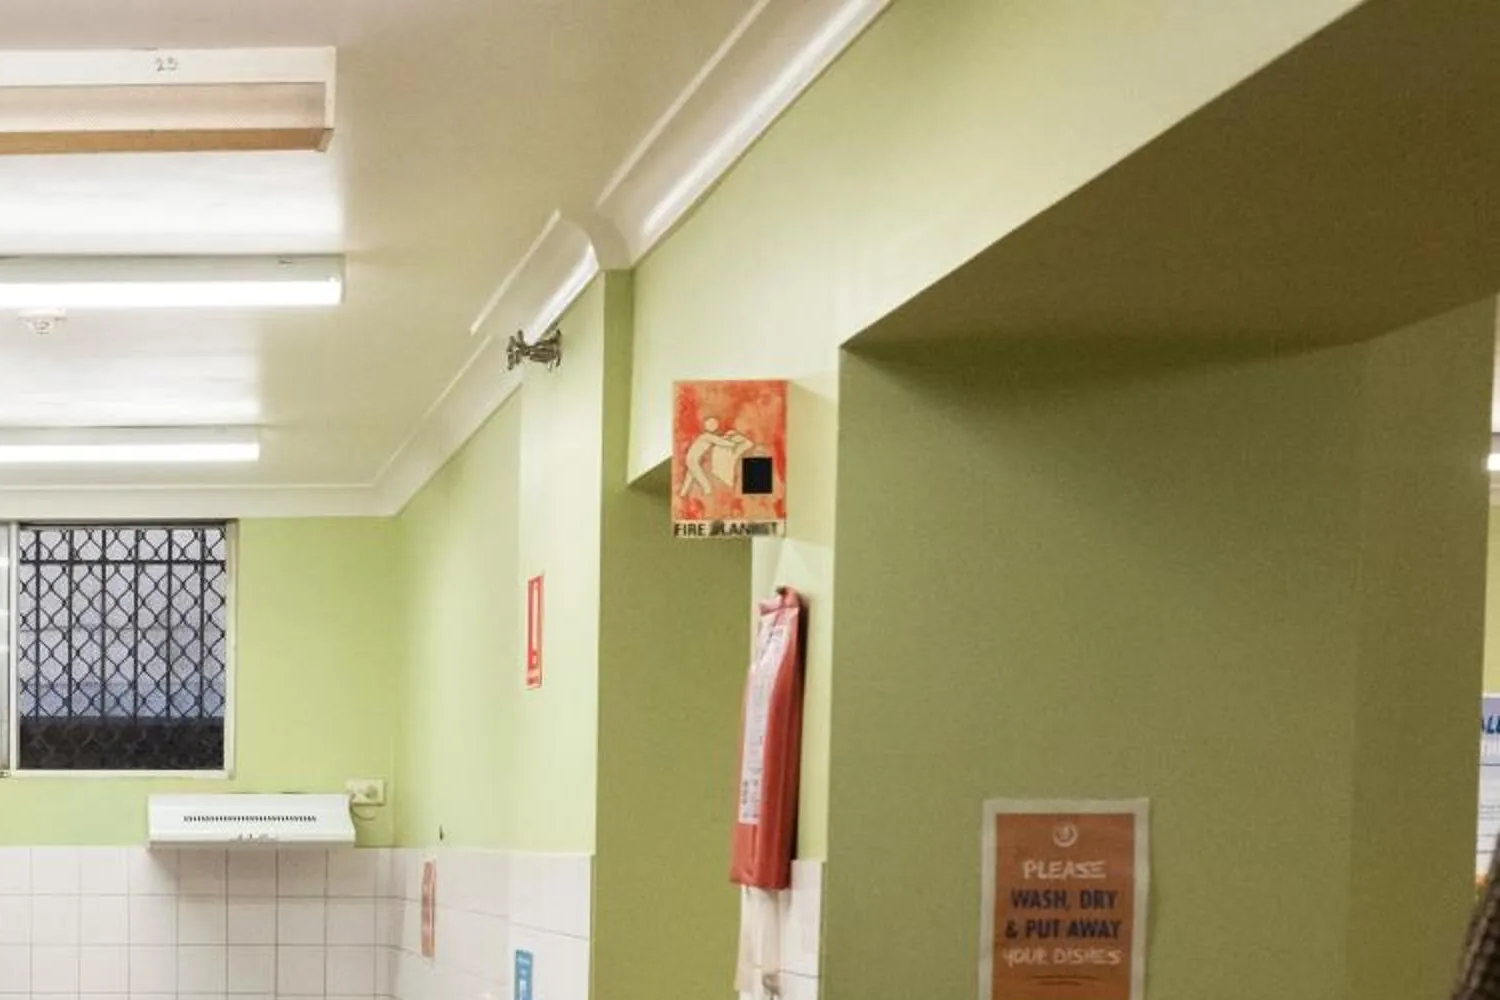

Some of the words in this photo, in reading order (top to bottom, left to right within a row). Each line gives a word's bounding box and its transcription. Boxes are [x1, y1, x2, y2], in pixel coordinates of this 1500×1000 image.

[674, 523, 707, 537] FIRE
[710, 522, 778, 537] LANT
[1022, 860, 1107, 881] PLEASE
[1011, 889, 1071, 912] WASH,
[1079, 889, 1119, 910] DRY
[1004, 919, 1019, 939] &
[1025, 919, 1062, 939] PUT
[1067, 918, 1123, 940] AWAY
[1003, 947, 1048, 968] YOUR
[1053, 947, 1122, 966] DISHES
